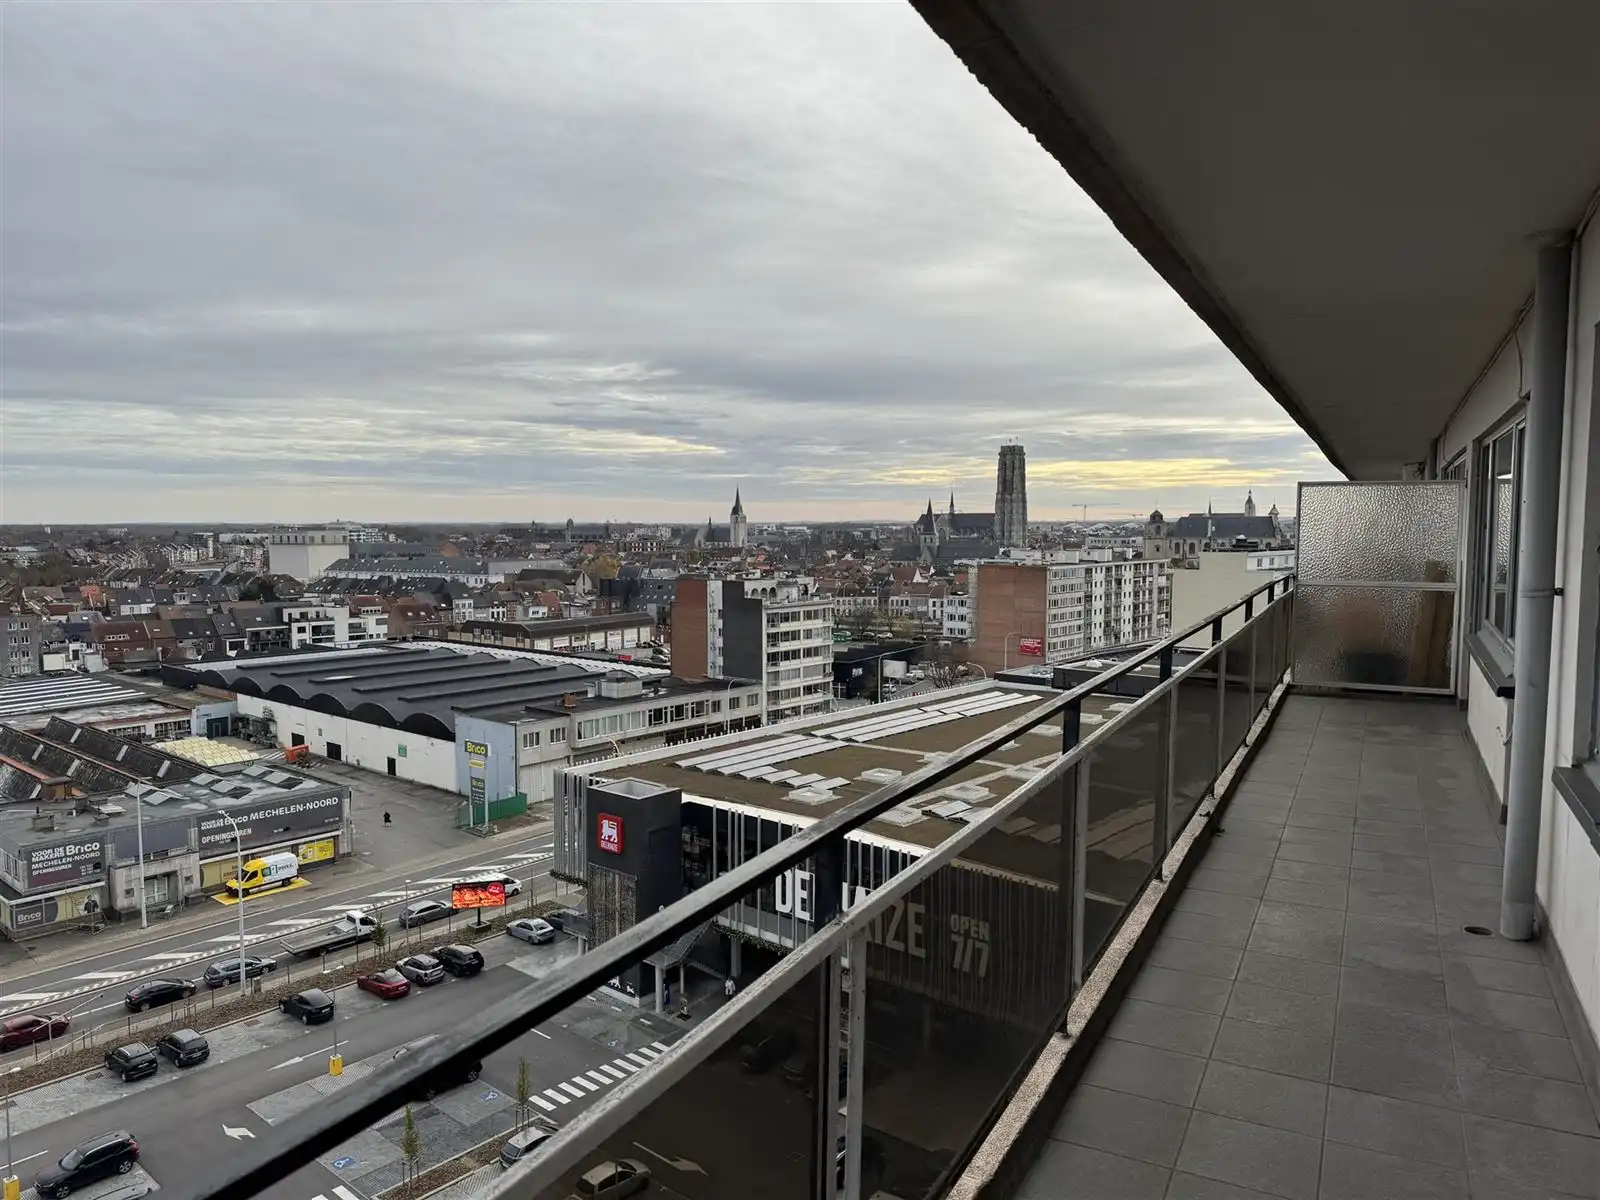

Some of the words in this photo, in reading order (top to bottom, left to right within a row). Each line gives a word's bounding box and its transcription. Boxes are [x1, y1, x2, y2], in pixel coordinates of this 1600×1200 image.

[466, 742, 486, 754] Brico
[250, 797, 339, 821] MECHELEN-NOORD
[31, 848, 53, 857] VOOR
[54, 846, 65, 854] DE
[66, 842, 100, 856] Brico
[31, 852, 65, 862] MAKERS
[31, 851, 100, 870] MECHELEN-NOORD
[17, 911, 42, 922] Brico
[950, 914, 990, 939] OPEN
[950, 934, 990, 978] 7/7
